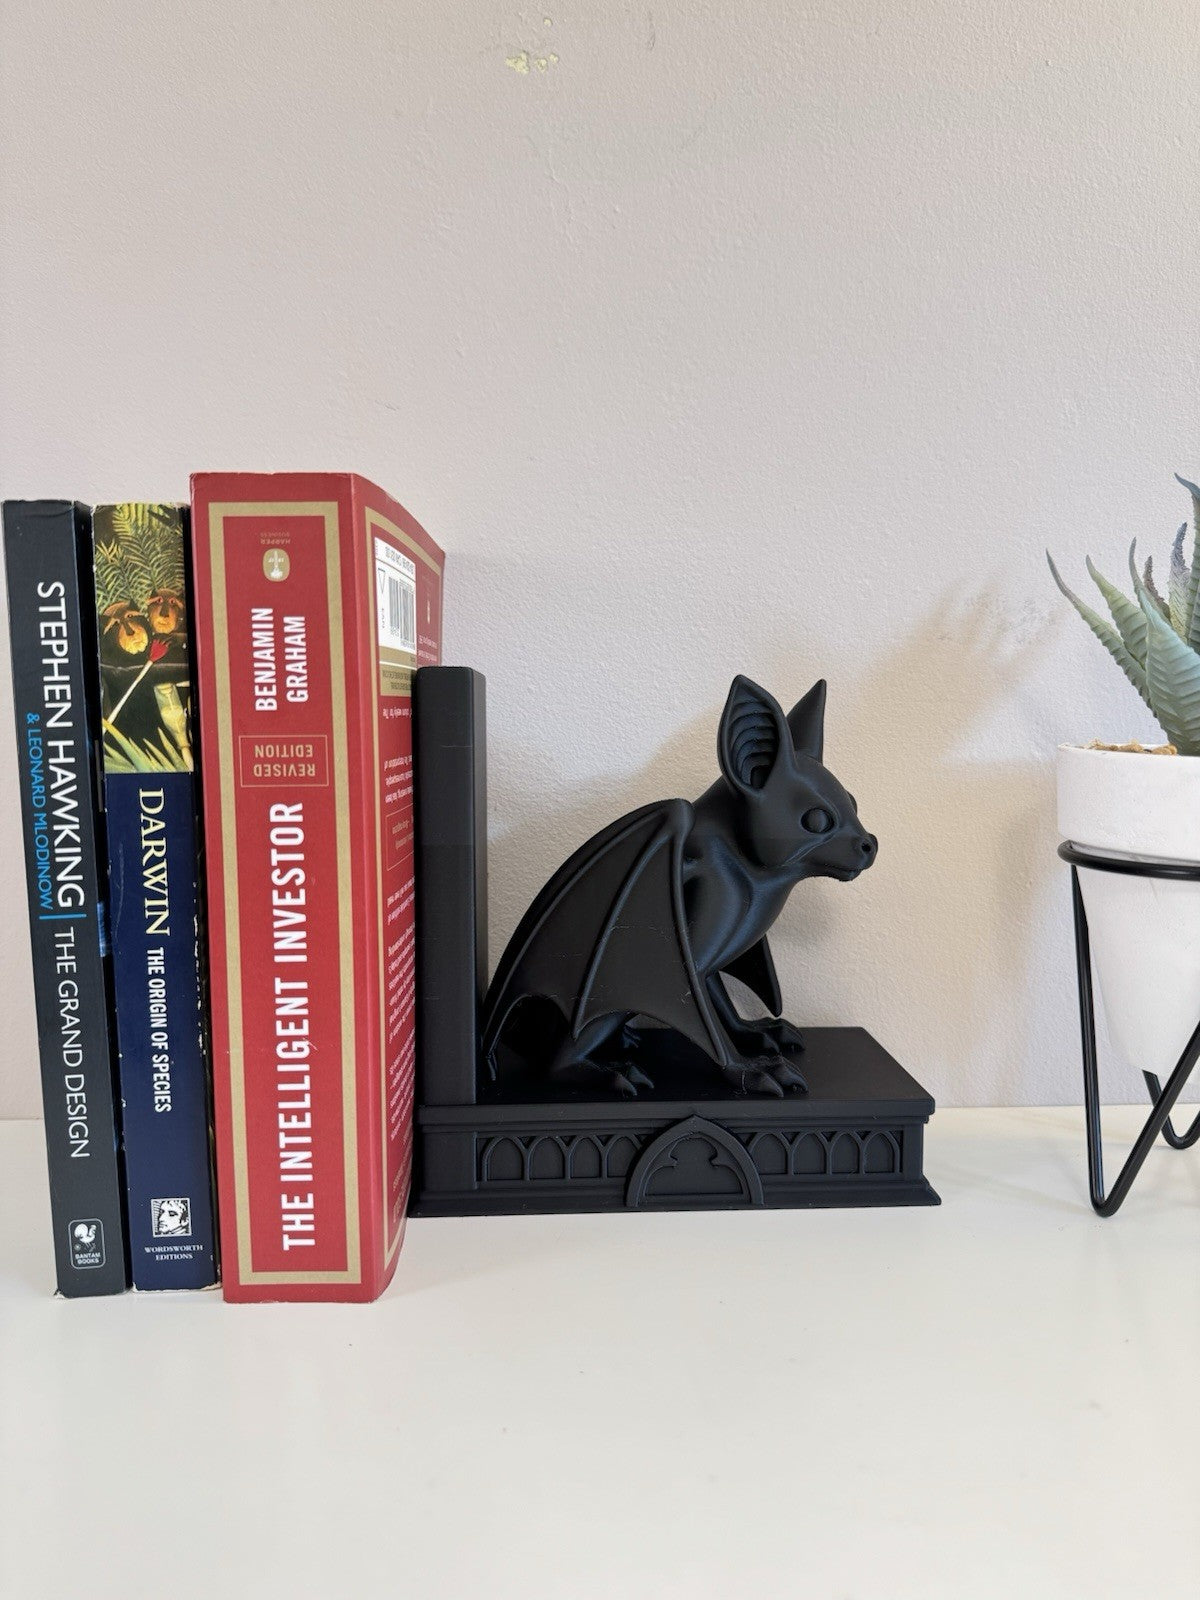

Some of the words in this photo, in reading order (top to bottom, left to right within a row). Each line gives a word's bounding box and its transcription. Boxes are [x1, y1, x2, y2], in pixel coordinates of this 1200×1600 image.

[259, 537, 291, 545] HARPER
[37, 581, 73, 728] STEPHEN
[251, 608, 277, 711] BENJAMIN
[283, 616, 309, 703] GRAHAM
[27, 713, 40, 724] &
[27, 727, 46, 808] LEONARD
[253, 763, 316, 777] REVISED
[254, 744, 313, 758] EDITION
[48, 739, 85, 908] HAWKING
[33, 813, 53, 910] MLODINOW
[139, 787, 170, 937] DARWIN
[270, 802, 307, 962] INVESTOR
[54, 926, 77, 974] THE
[147, 947, 165, 975] THE
[58, 979, 83, 1068] GRAND
[148, 978, 168, 1028] ORIGIN
[151, 1032, 169, 1050] OF
[152, 1054, 172, 1113] SPECIES
[274, 977, 314, 1181] INTELLIGENT
[65, 1075, 91, 1158] DESIGN
[144, 1244, 204, 1253] WORDSWORTH
[281, 1193, 316, 1251] THE
[75, 1251, 101, 1259] BANTAM
[155, 1253, 193, 1261] EDITIONS
